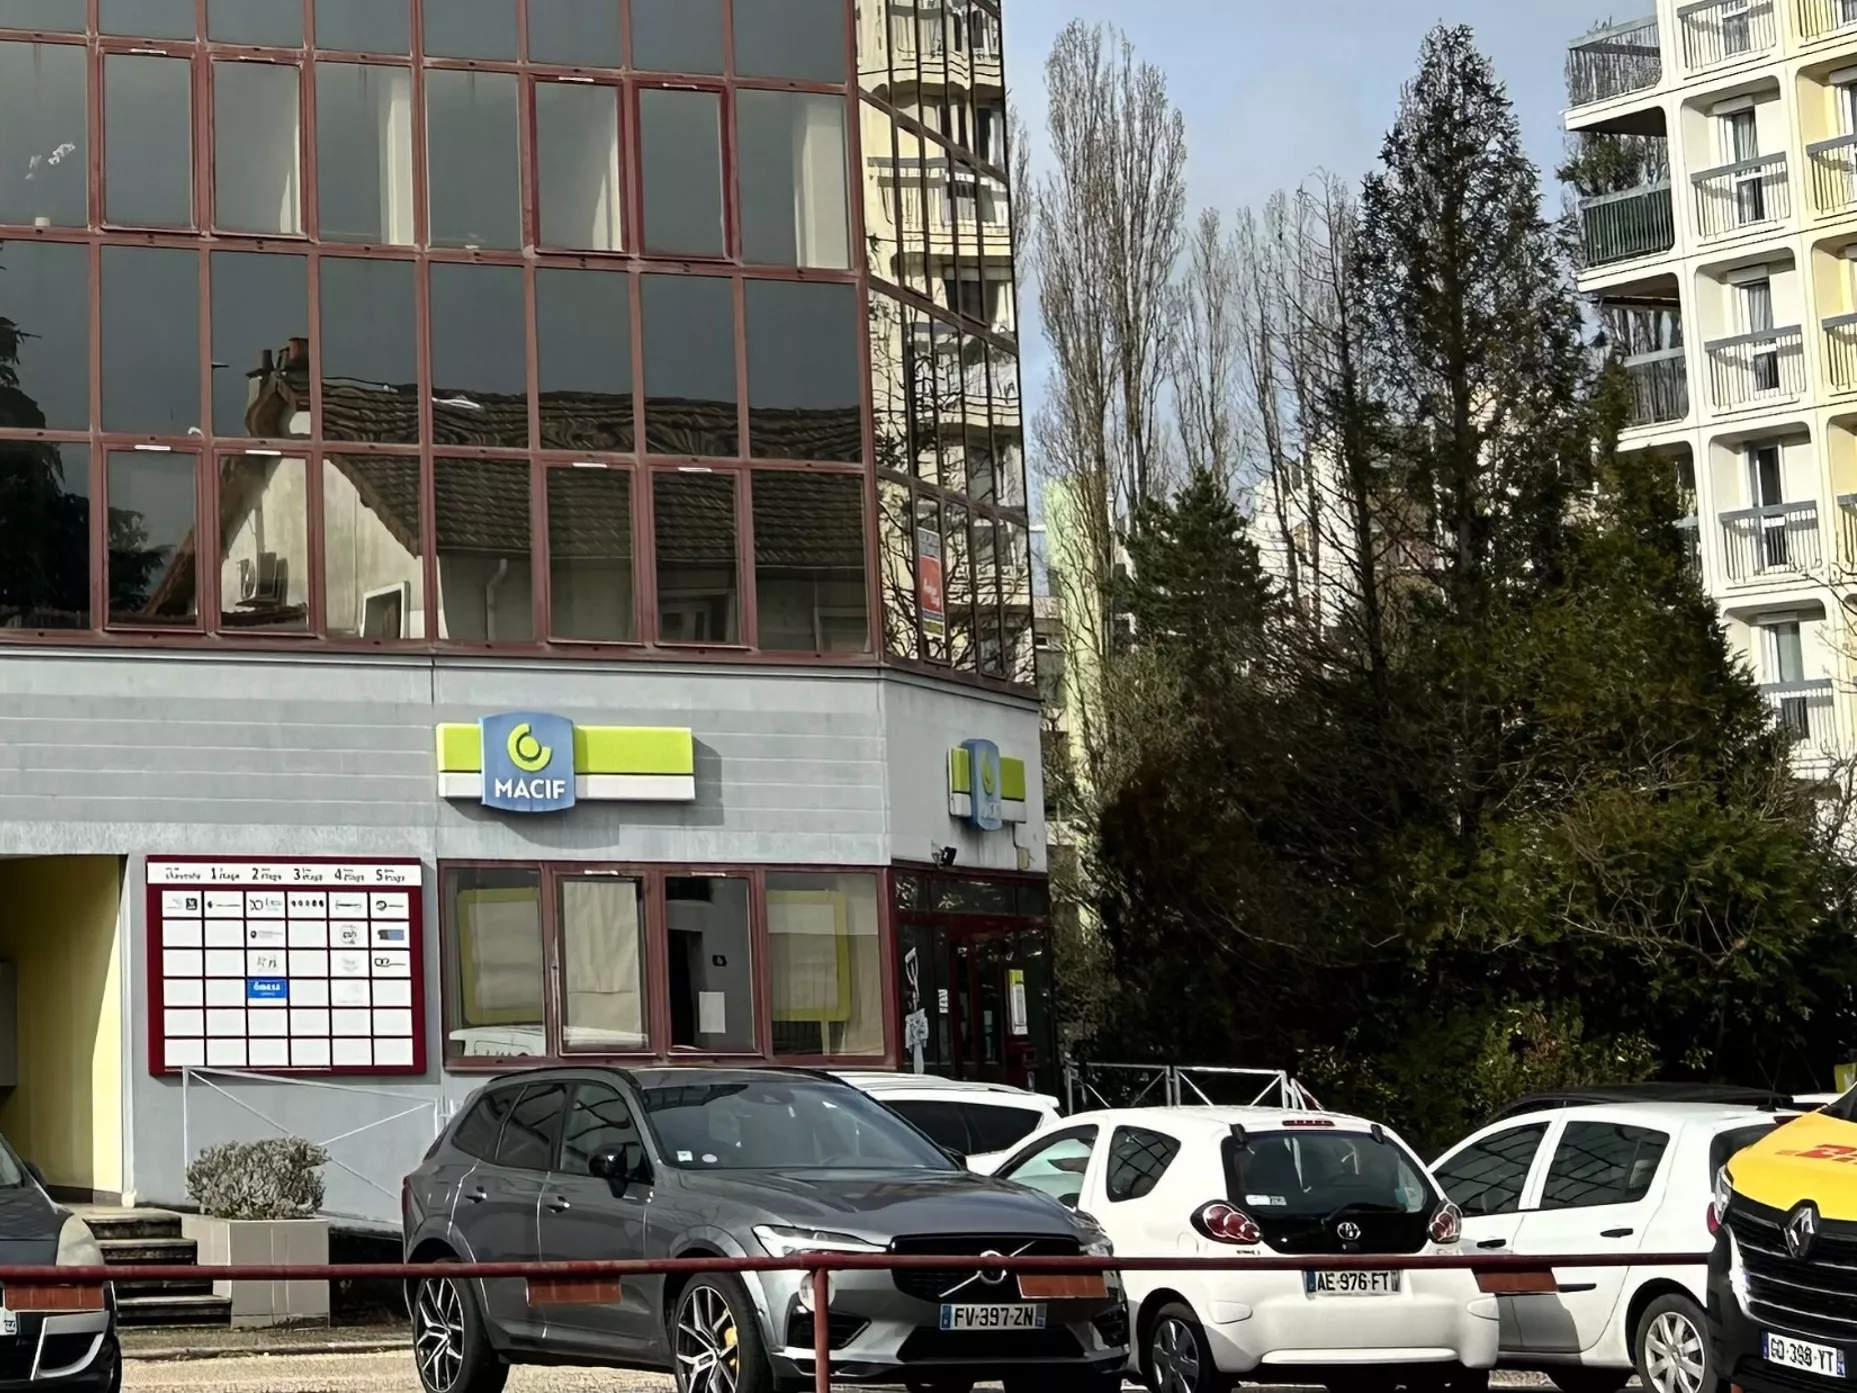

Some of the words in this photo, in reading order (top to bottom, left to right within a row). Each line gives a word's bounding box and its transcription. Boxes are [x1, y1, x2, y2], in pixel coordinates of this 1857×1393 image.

[495, 778, 566, 800] MACIF
[211, 867, 217, 880] 1
[252, 867, 259, 880] 2
[293, 868, 301, 880] 3
[334, 868, 342, 881] 4
[375, 869, 383, 881] 5
